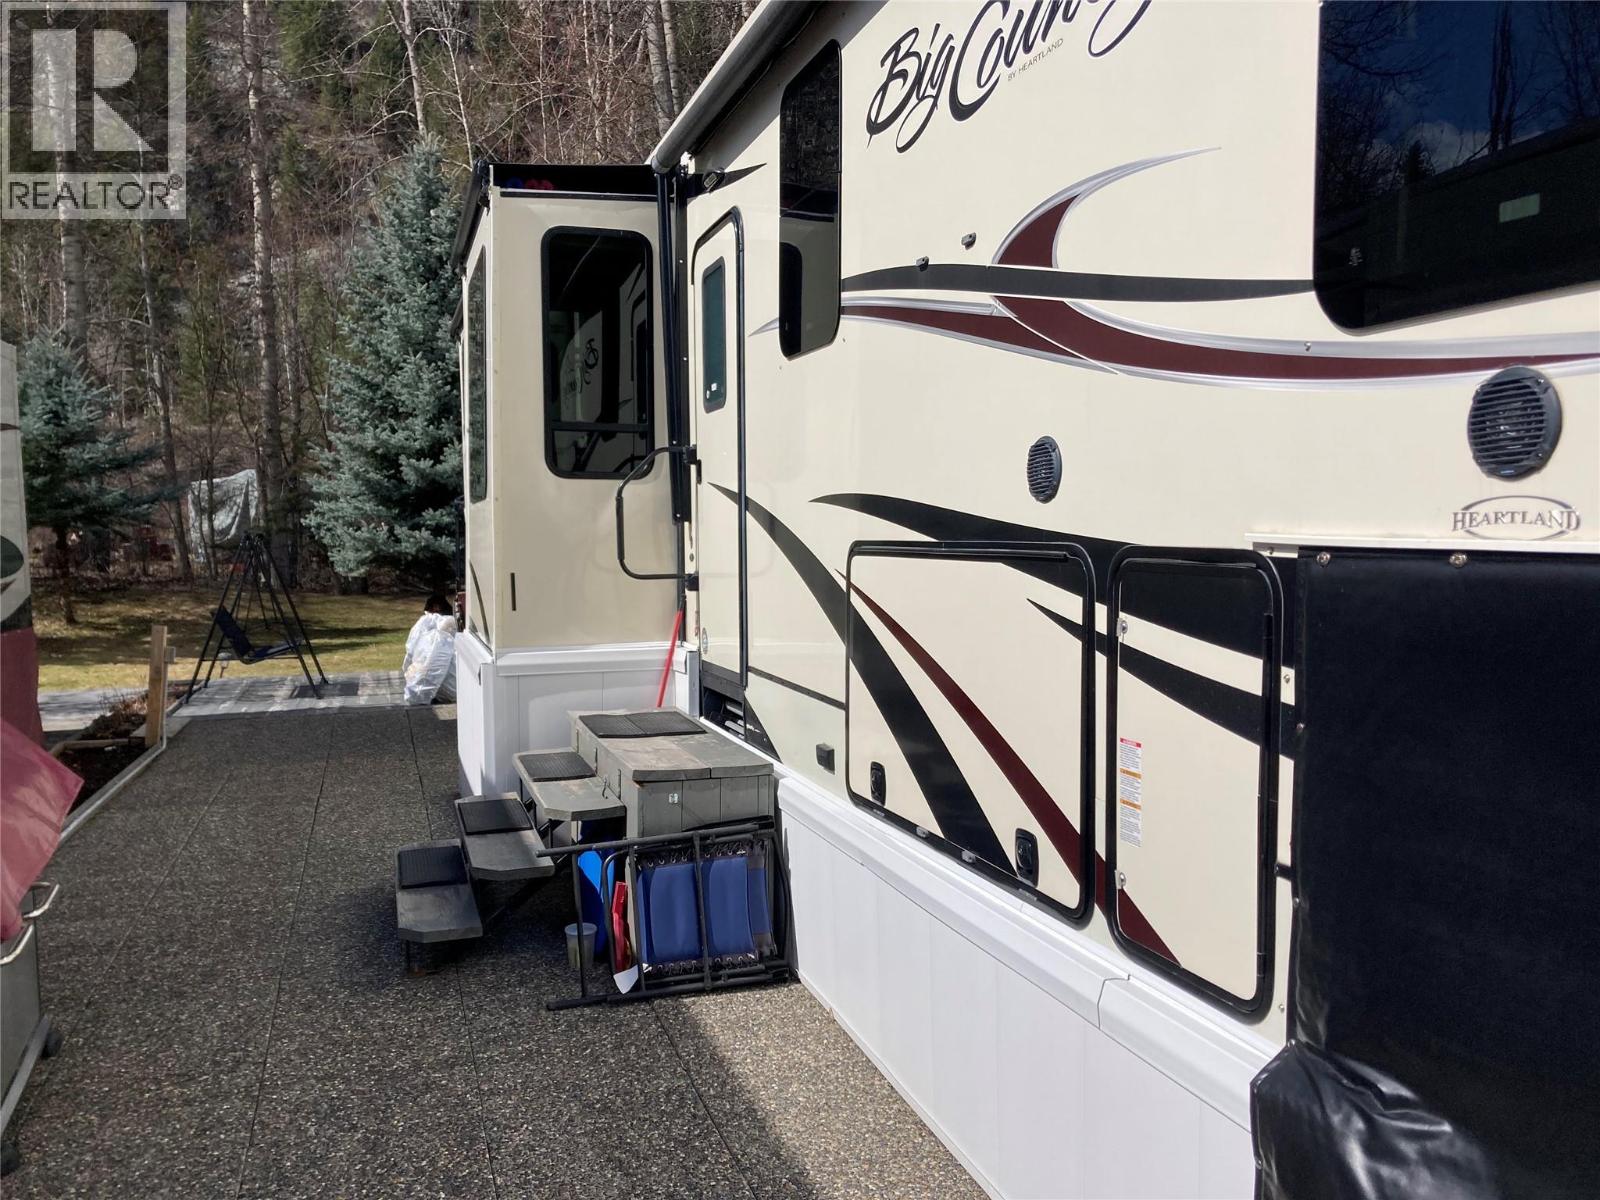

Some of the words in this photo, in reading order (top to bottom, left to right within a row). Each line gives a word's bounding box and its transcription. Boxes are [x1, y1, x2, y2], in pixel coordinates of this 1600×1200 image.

[1007, 69, 1017, 82] BY
[1018, 38, 1064, 74] HEARTLAND
[866, 22, 956, 154] Big
[1452, 510, 1581, 532] HEARTLAND
